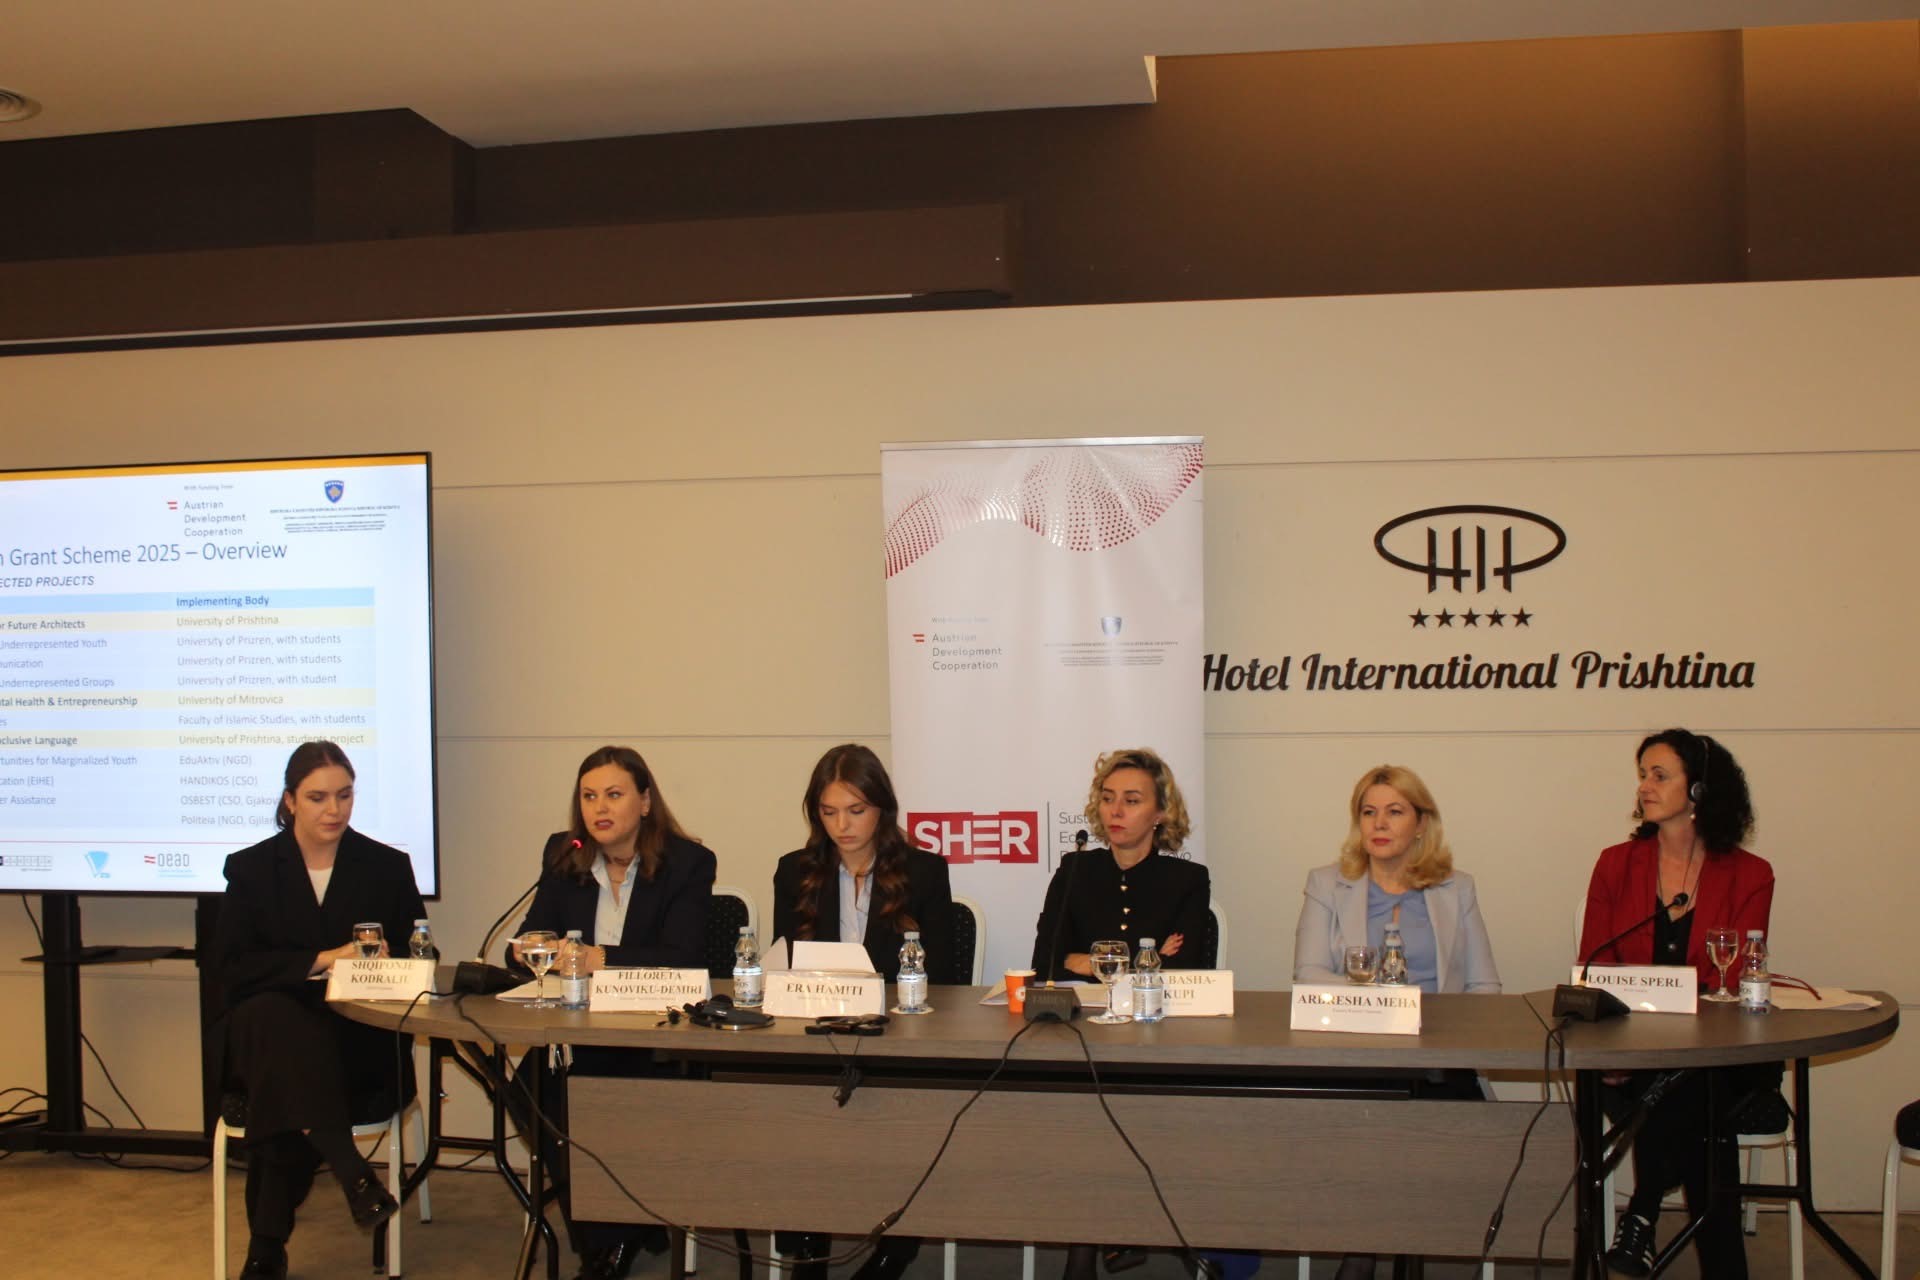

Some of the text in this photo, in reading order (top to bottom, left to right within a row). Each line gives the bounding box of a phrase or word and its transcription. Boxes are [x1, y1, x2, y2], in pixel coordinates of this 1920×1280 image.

[184, 501, 224, 510] Austrian
[184, 513, 246, 525] Development
[184, 526, 243, 538] Cooperation
[10, 548, 58, 566] Grant
[63, 545, 131, 565] Scheme
[137, 544, 181, 563] 2025
[203, 542, 287, 561] Overview
[36, 576, 95, 587] PROJECTS
[177, 595, 270, 608] Implementing Body
[8, 621, 38, 630] Future
[40, 620, 86, 630] Architects
[177, 614, 279, 628] University of Prishtina
[81, 638, 108, 648] Youth
[177, 636, 223, 648] University
[226, 635, 235, 646] of
[277, 634, 297, 644] with
[300, 634, 341, 644] students
[932, 632, 977, 643] Austrian
[932, 646, 1003, 659] Development
[0, 658, 44, 669] unication
[177, 655, 223, 668] University
[226, 655, 236, 666] of
[277, 654, 298, 664] with
[300, 654, 342, 664] students
[932, 660, 999, 672] Cooperation
[1202, 650, 1756, 692] Hotel International Prishtina
[82, 677, 115, 689] Groups
[178, 675, 224, 687] University
[227, 675, 236, 685] of
[277, 674, 298, 684] with
[301, 674, 337, 684] student
[16, 697, 45, 706] Health
[48, 697, 55, 706] &
[58, 696, 138, 708] Entrepreneurship
[178, 693, 284, 707] University of Mitrovica
[179, 713, 366, 726] Faculty of Islamic Studies, with students
[35, 735, 78, 747] Language
[179, 734, 225, 745] University
[229, 734, 238, 744] of
[240, 733, 284, 745] Prishtina,
[330, 734, 364, 745] project
[36, 755, 49, 765] for
[52, 755, 109, 767] Marginalized
[111, 755, 138, 765] Youth
[222, 754, 252, 766] (NGO)
[180, 775, 258, 787] HANDIKOS (CSO)
[10, 795, 57, 805] Assistance
[180, 796, 215, 806] OSBEST
[246, 796, 278, 808] Gjakov
[913, 819, 1031, 856] SHER
[352, 960, 416, 971] SHQIPONJE
[1169, 975, 1216, 985] BASHA-
[1588, 975, 1684, 988] LOUISE SPERL
[786, 983, 863, 996] ERA HAMITI
[1163, 989, 1195, 999] KUPI
[1376, 996, 1417, 1008] MEHA
